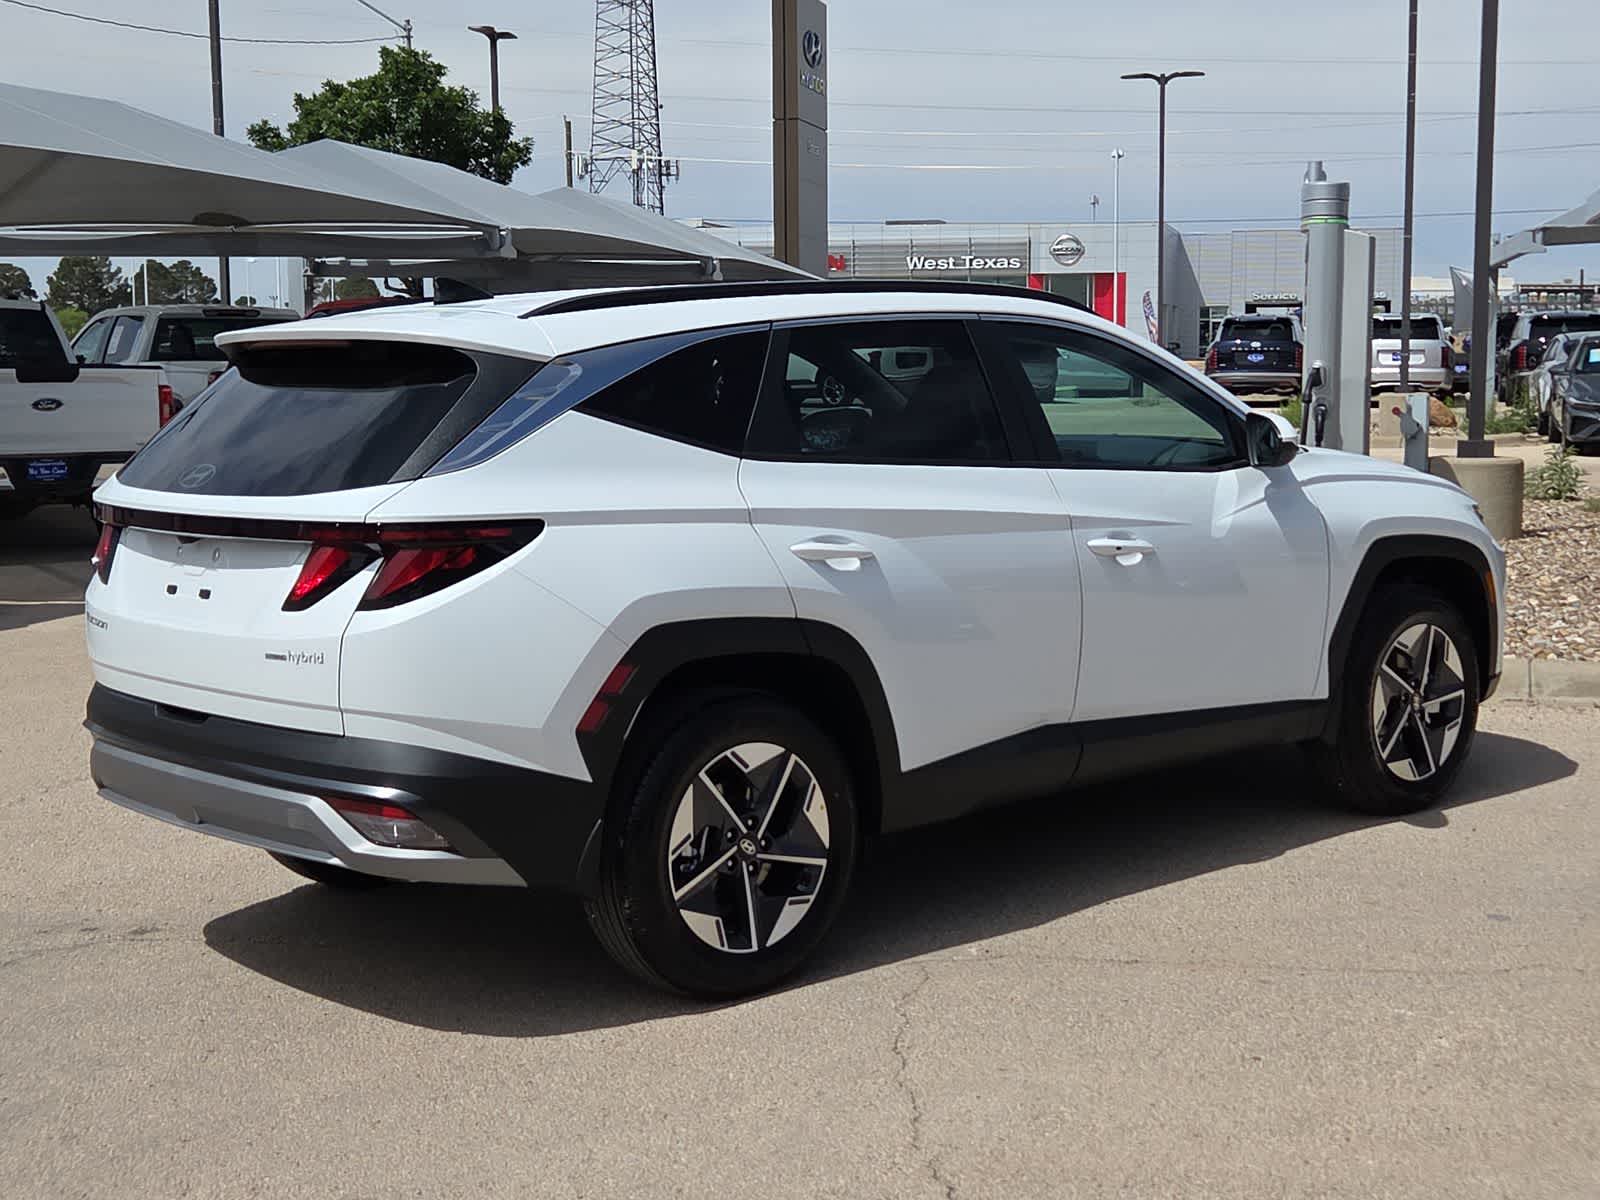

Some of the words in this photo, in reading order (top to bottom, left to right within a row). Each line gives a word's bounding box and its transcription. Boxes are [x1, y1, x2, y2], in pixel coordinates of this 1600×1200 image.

[906, 256, 956, 270] West
[961, 255, 1021, 269] Texas
[287, 651, 324, 665] hybrid
